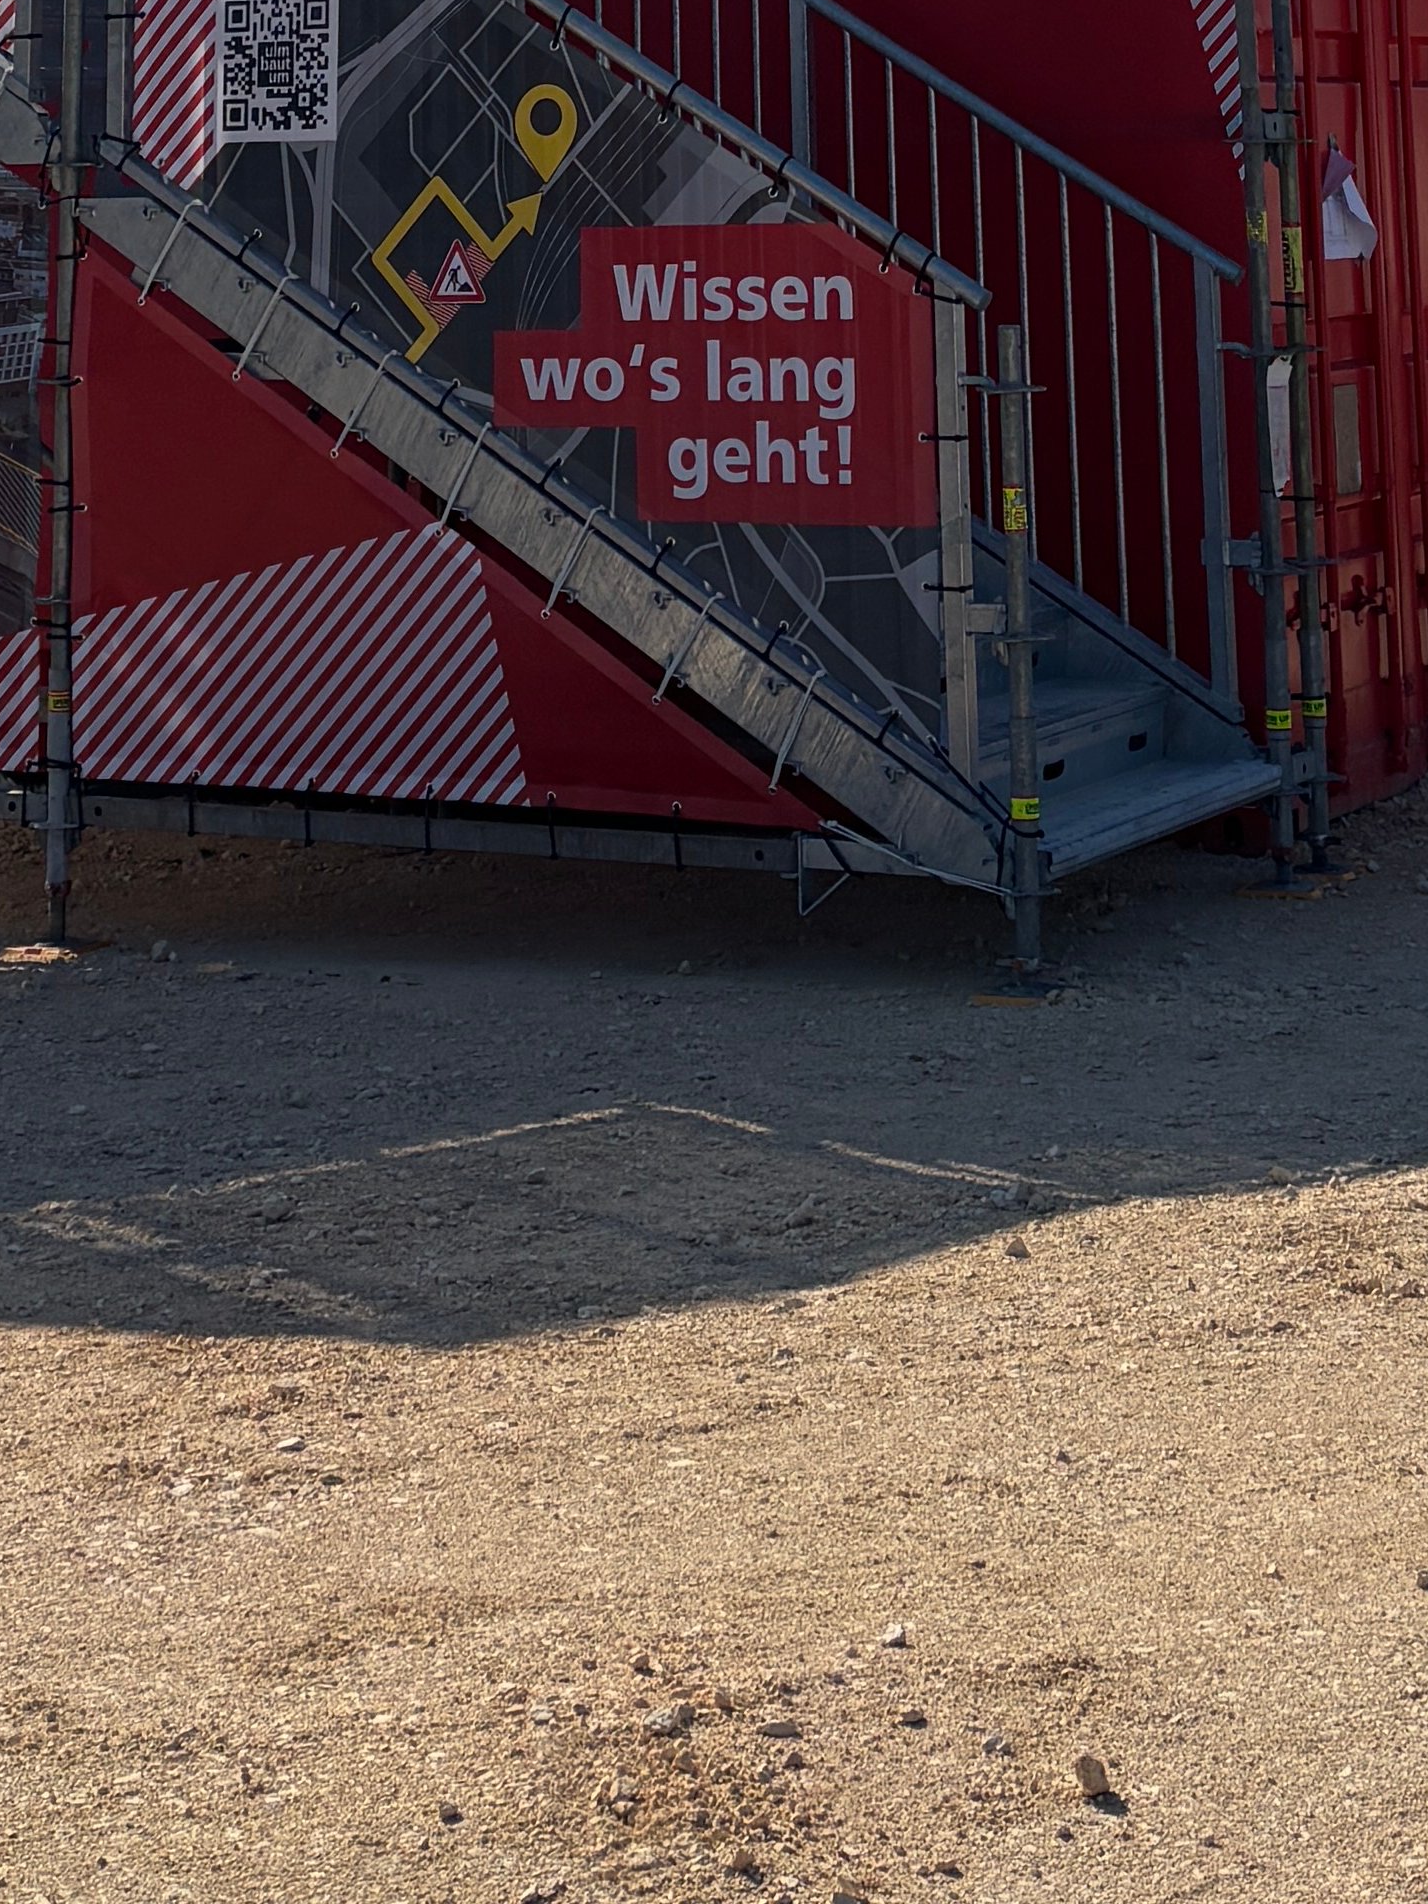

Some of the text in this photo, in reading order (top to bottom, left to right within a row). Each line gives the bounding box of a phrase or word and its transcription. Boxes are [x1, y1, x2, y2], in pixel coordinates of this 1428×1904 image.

[260, 55, 291, 71] baut
[265, 41, 290, 58] ulm
[268, 72, 290, 84] um
[613, 260, 854, 322] Wissen
[706, 339, 856, 420] lang
[667, 420, 853, 500] geht!
